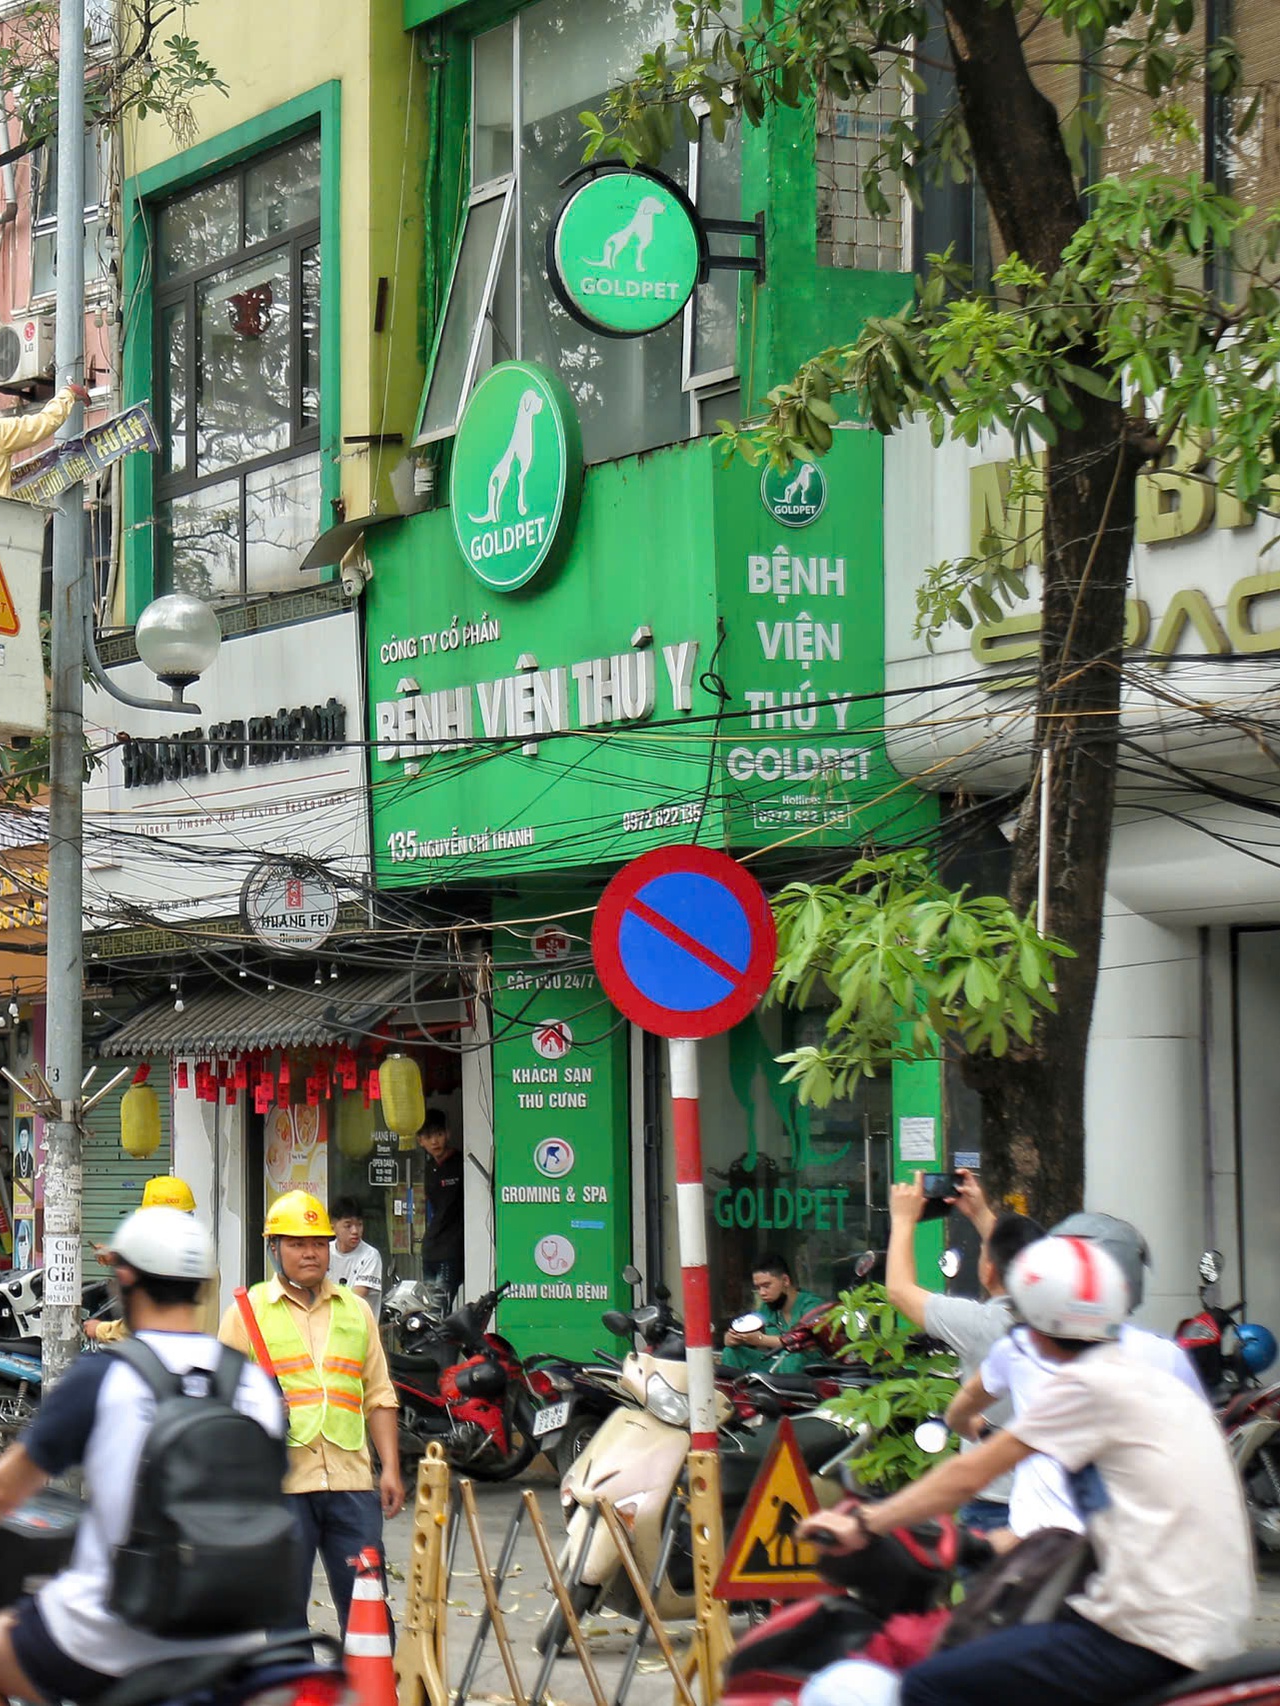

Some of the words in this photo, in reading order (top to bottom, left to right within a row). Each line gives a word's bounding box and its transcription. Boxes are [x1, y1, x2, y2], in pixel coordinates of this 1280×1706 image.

[579, 276, 680, 301] GOLDPET
[24, 343, 34, 353] LG
[773, 503, 817, 516] GOLDPET
[469, 515, 547, 561] GOLDPET
[746, 544, 846, 604] BỆNH
[380, 634, 418, 665] CÔNG
[419, 632, 438, 656] TY
[439, 615, 460, 652] CỔ
[462, 611, 501, 646] PHẦN
[756, 611, 842, 670] VIỆN
[375, 677, 473, 779] BỆNH
[476, 653, 569, 756] VIỆN
[662, 641, 699, 711] Y
[744, 680, 817, 730] THÚ
[823, 691, 854, 730] Y
[727, 746, 871, 783] GOLDPET
[387, 830, 417, 864] 135
[418, 826, 469, 859] NGUYỄN
[469, 827, 492, 852] CHÍ
[492, 826, 535, 850] THANH
[261, 914, 306, 929] HUANG
[310, 913, 329, 928] FEI
[563, 972, 595, 989] 24/7
[512, 1063, 557, 1083] KHÁCH
[564, 1067, 592, 1087] SẠN
[517, 1090, 542, 1110] THÚ
[548, 1092, 587, 1109] CƯNG
[501, 1185, 560, 1203] GROMING
[565, 1186, 576, 1202] &
[582, 1185, 608, 1203] SPA
[713, 1187, 850, 1231] GOLDPET
[47, 1267, 75, 1283] Giá
[540, 1279, 572, 1299] CHỮA
[575, 1281, 608, 1301] BỆNH
